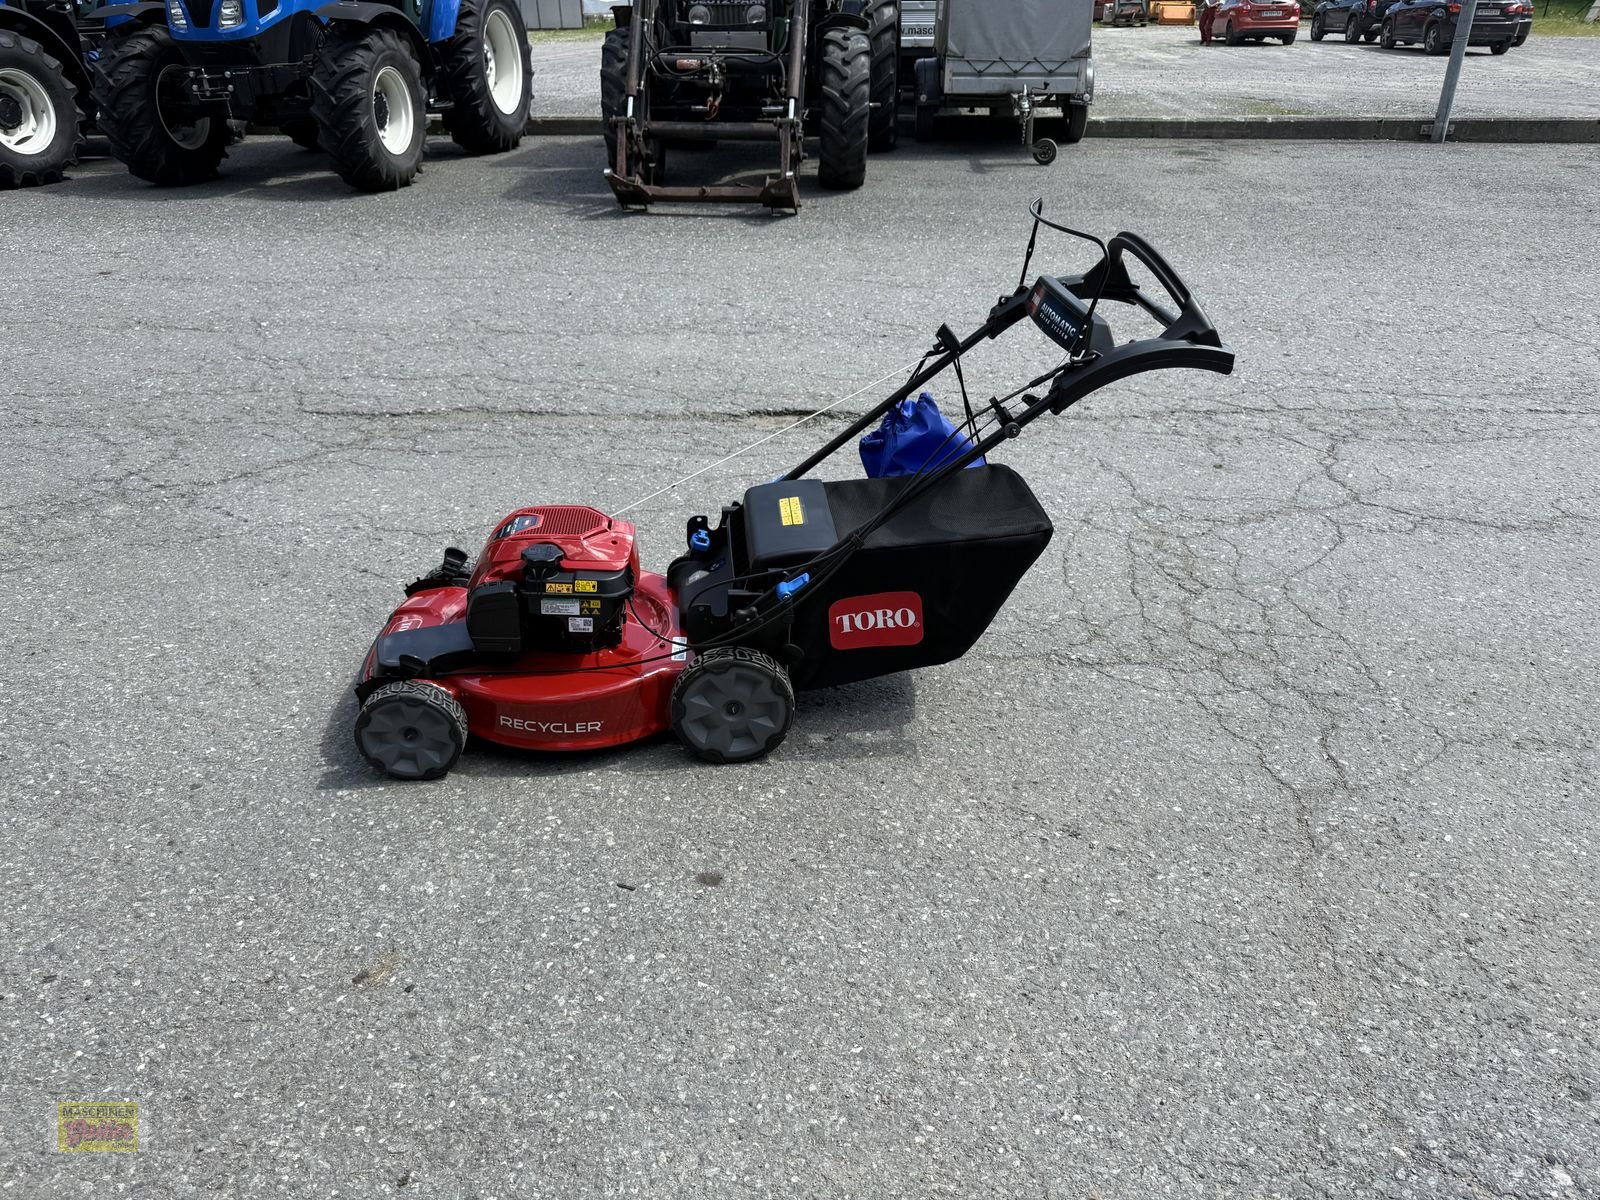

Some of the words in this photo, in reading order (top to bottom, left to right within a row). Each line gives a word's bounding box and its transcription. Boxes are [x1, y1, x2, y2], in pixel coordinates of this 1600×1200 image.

[1041, 303, 1076, 337] AUTOMATIC
[835, 607, 916, 634] TORO
[500, 715, 602, 733] RECYCLER
